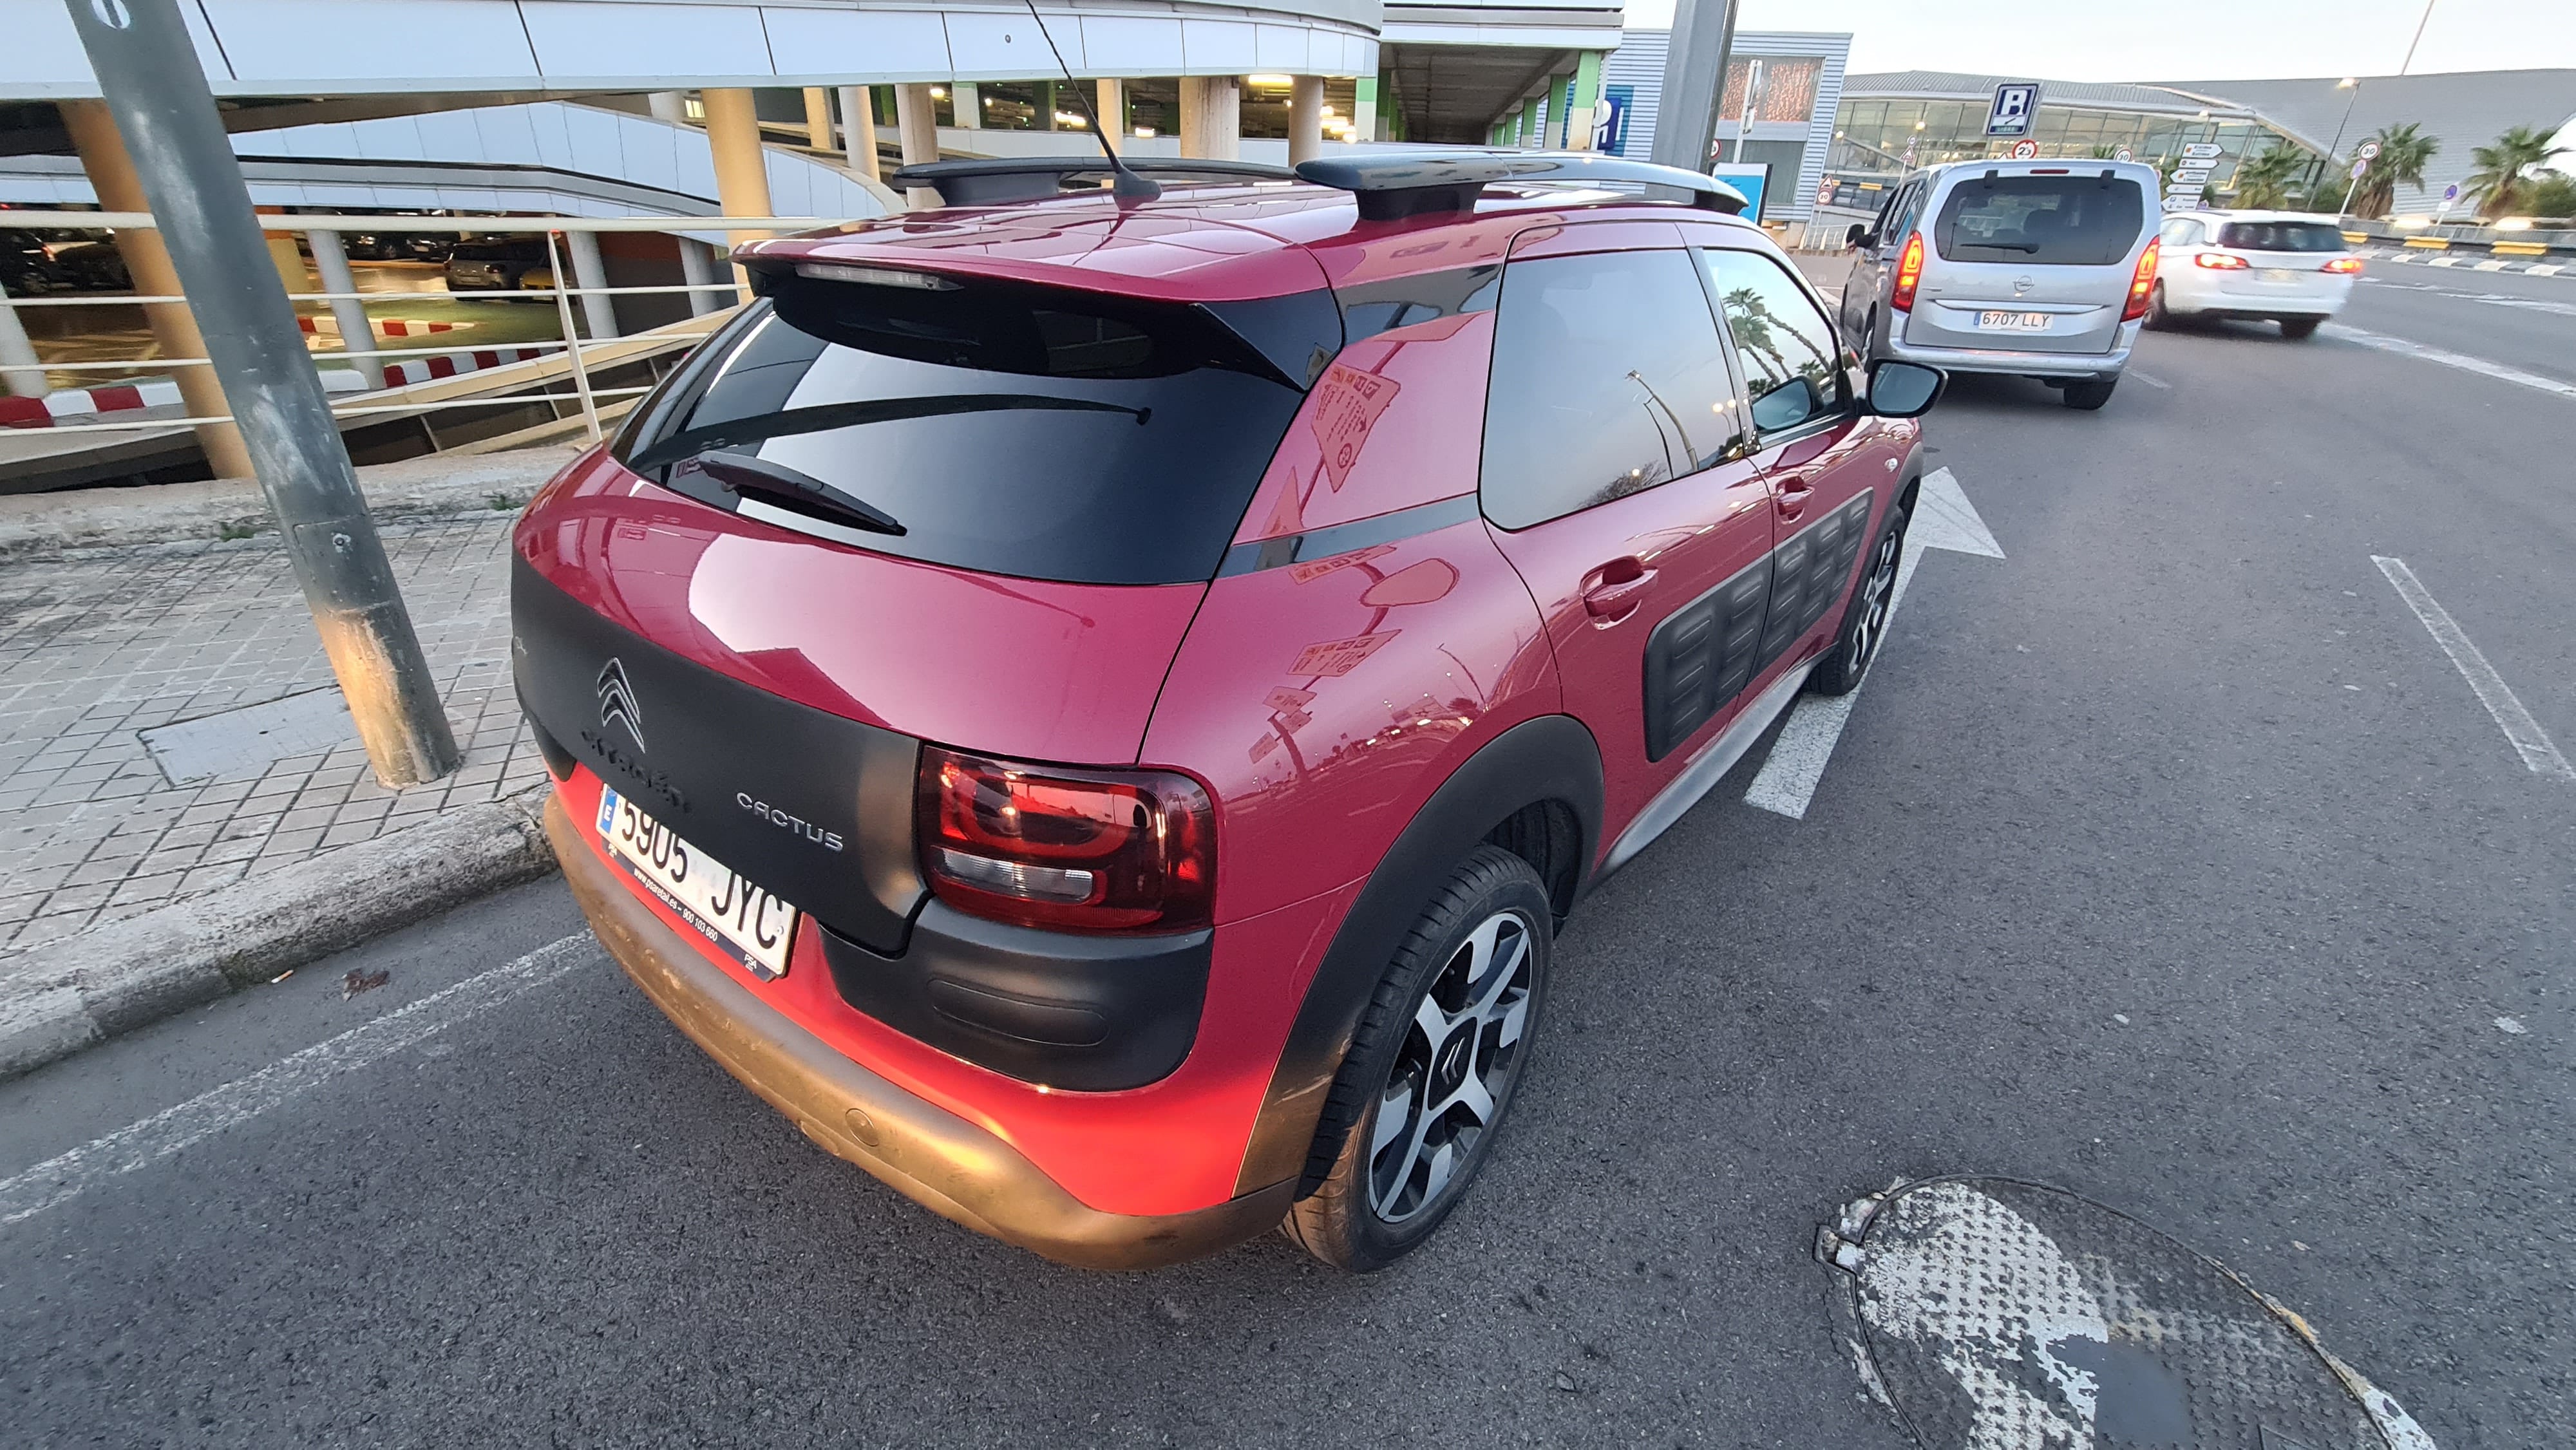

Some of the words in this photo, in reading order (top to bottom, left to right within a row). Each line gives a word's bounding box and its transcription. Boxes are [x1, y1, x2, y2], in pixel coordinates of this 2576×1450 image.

[1983, 313, 2018, 326] 6707
[2022, 314, 2049, 327] LLY
[603, 804, 612, 822] E
[737, 792, 843, 851] CACTUS
[622, 797, 688, 883] 5905
[711, 870, 777, 949] JYC
[634, 867, 677, 909] www.psaretail.es
[683, 909, 694, 923] 900
[694, 918, 706, 932] 103
[706, 927, 718, 942] 660
[744, 954, 757, 969] PSA
